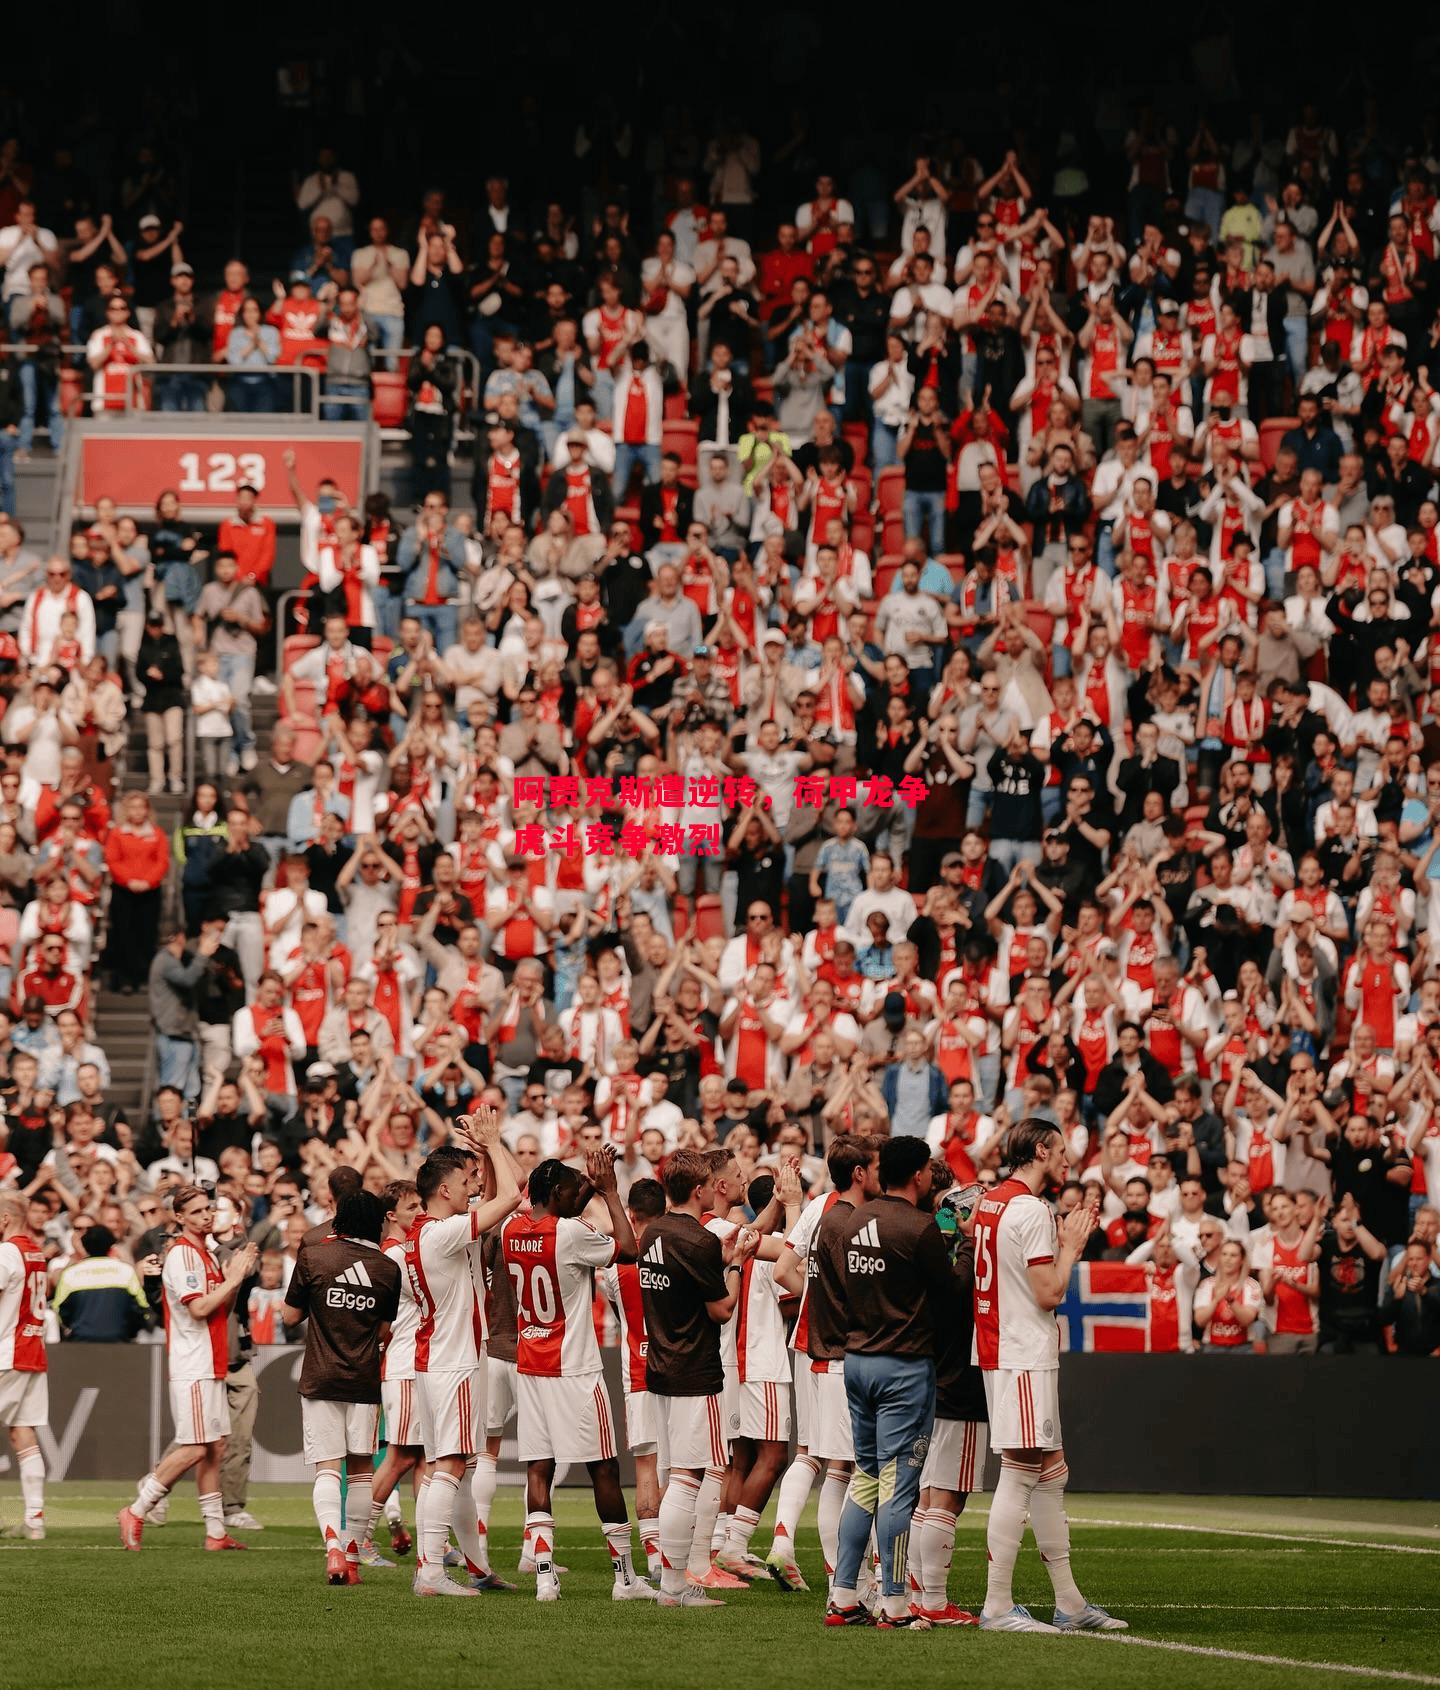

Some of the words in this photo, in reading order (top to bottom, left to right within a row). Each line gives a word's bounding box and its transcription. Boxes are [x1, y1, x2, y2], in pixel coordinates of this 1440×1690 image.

[179, 453, 266, 492] 123
[509, 1236, 543, 1253] TRAORÉ
[847, 1250, 886, 1275] Ziggo
[639, 1267, 670, 1291] Ziggo
[326, 1287, 376, 1312] Ziggo
[508, 1263, 556, 1324] 20
